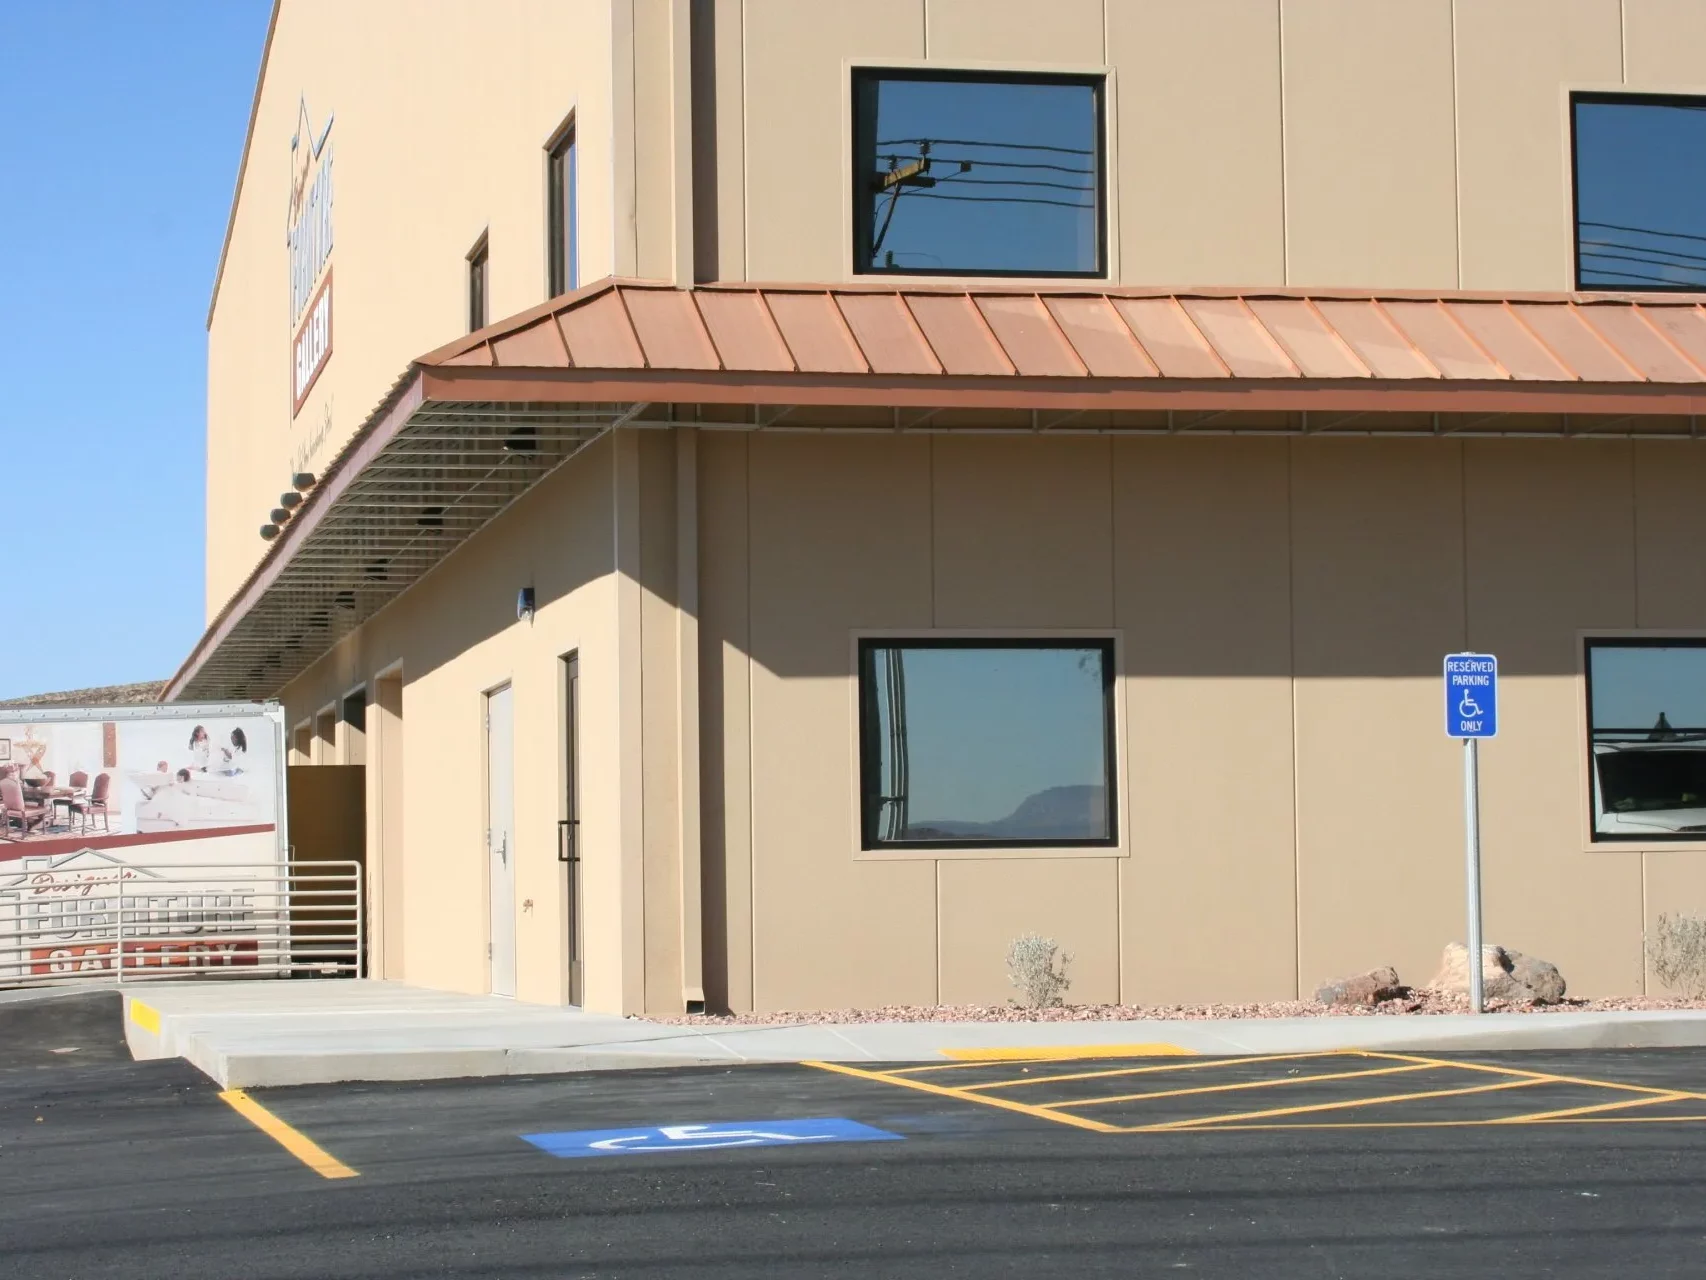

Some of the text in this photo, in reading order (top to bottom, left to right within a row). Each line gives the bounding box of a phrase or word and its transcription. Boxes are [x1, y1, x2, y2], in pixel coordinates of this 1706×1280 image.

[1447, 661, 1494, 673] RESERVED
[1452, 675, 1490, 686] PARKING
[1460, 720, 1483, 732] ONLY
